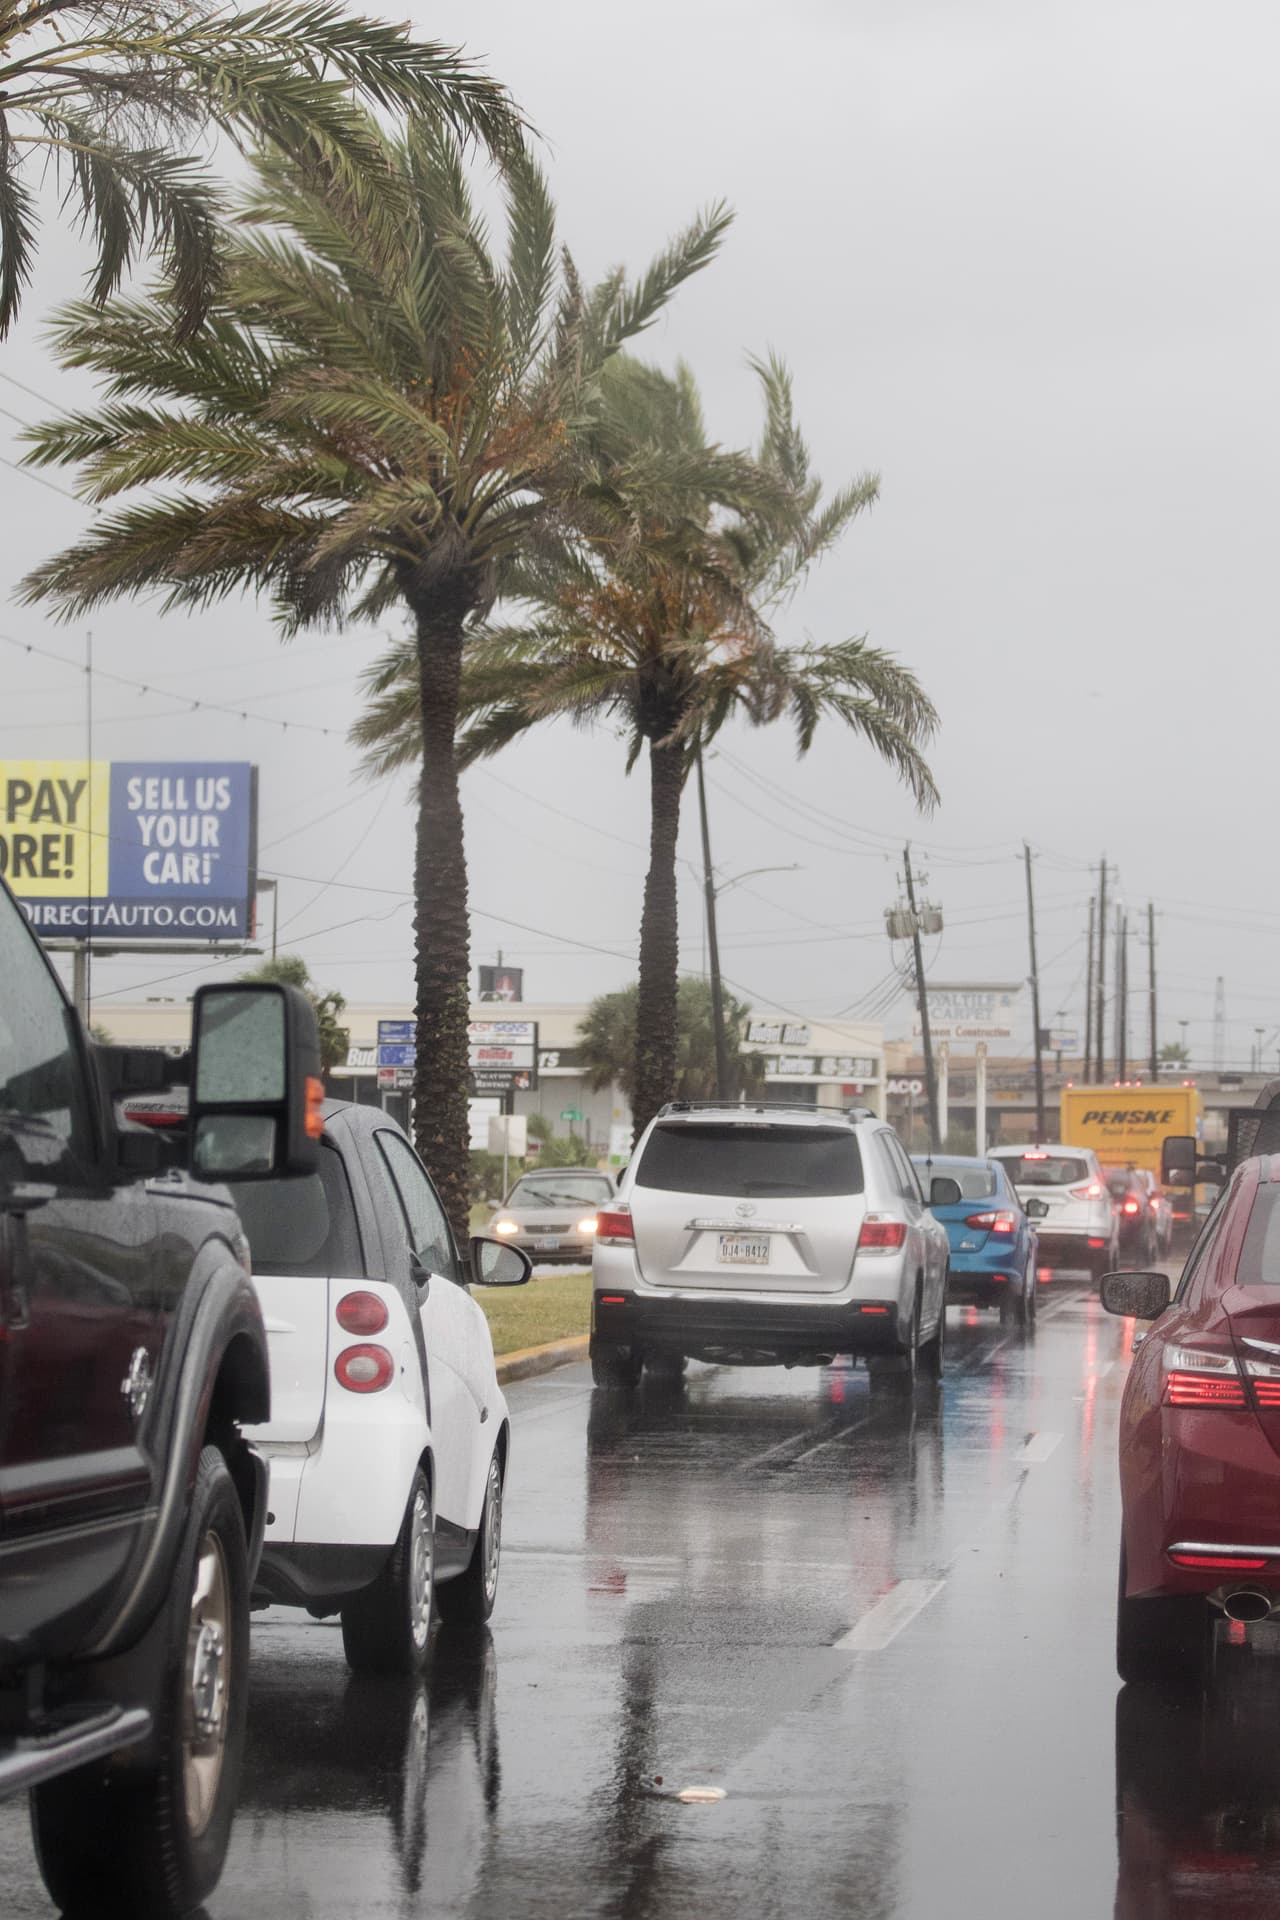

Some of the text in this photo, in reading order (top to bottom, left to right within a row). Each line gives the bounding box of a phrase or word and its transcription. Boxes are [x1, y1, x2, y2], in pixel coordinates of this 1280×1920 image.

[7, 779, 87, 823] PAY
[127, 777, 231, 811] SELL US
[137, 815, 220, 847] YOUR
[1082, 1109, 1176, 1125] PENSKE
